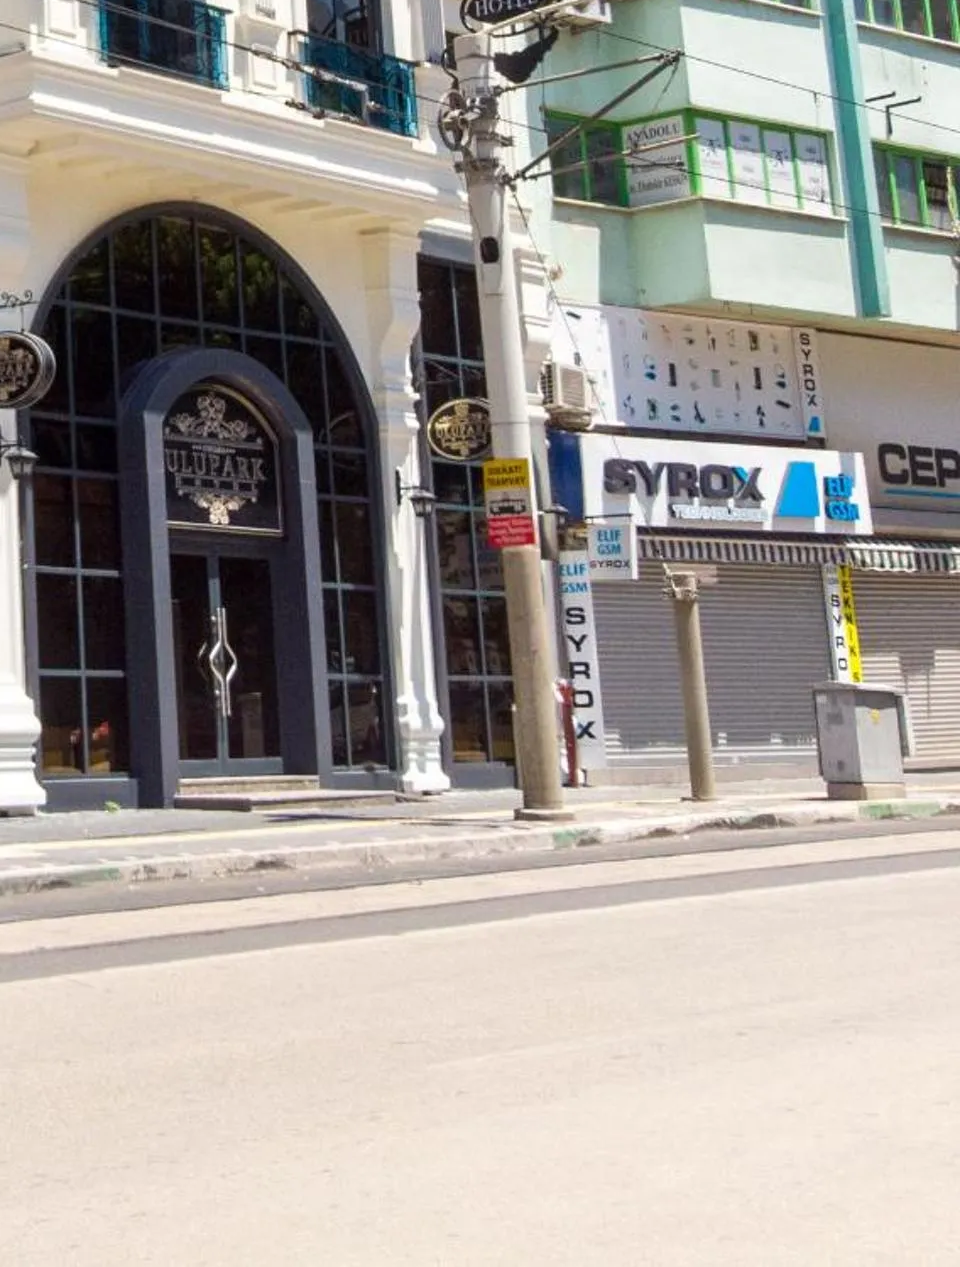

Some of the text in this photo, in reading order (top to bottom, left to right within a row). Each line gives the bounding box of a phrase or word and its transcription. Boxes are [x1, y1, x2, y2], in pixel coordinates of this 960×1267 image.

[799, 333, 818, 407] SYROX
[165, 449, 266, 481] ULUPARK
[603, 458, 765, 502] SYROX
[878, 443, 960, 488] CEP
[830, 594, 848, 671] SYRO
[565, 606, 596, 740] SYROX
